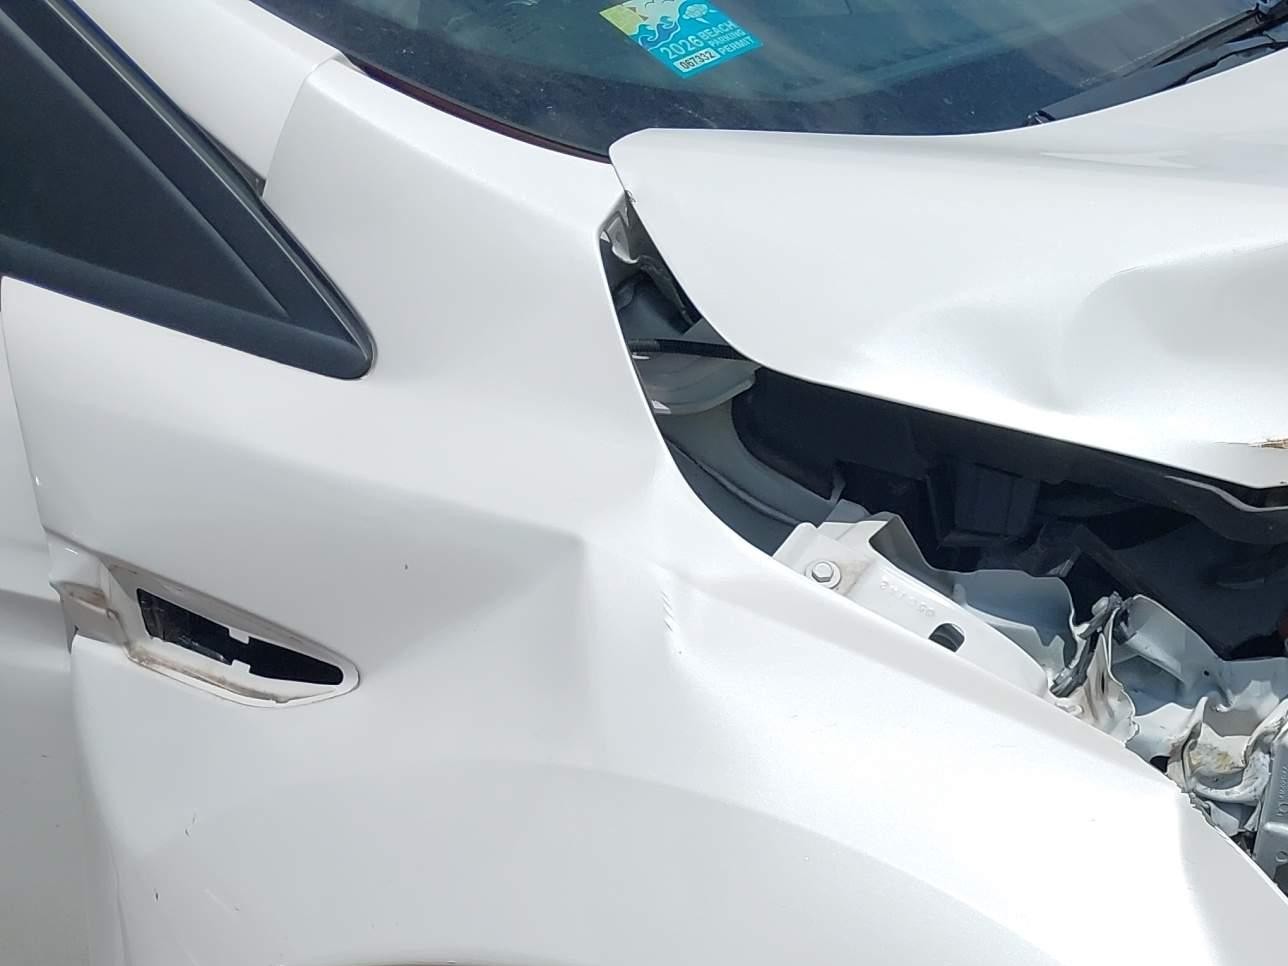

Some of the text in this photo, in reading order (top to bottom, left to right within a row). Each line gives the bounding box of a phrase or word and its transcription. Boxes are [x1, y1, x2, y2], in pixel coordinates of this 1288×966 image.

[699, 20, 739, 40] BEACH
[708, 30, 747, 48] PARKING
[660, 36, 704, 60] 2026
[718, 36, 754, 55] PERMIT
